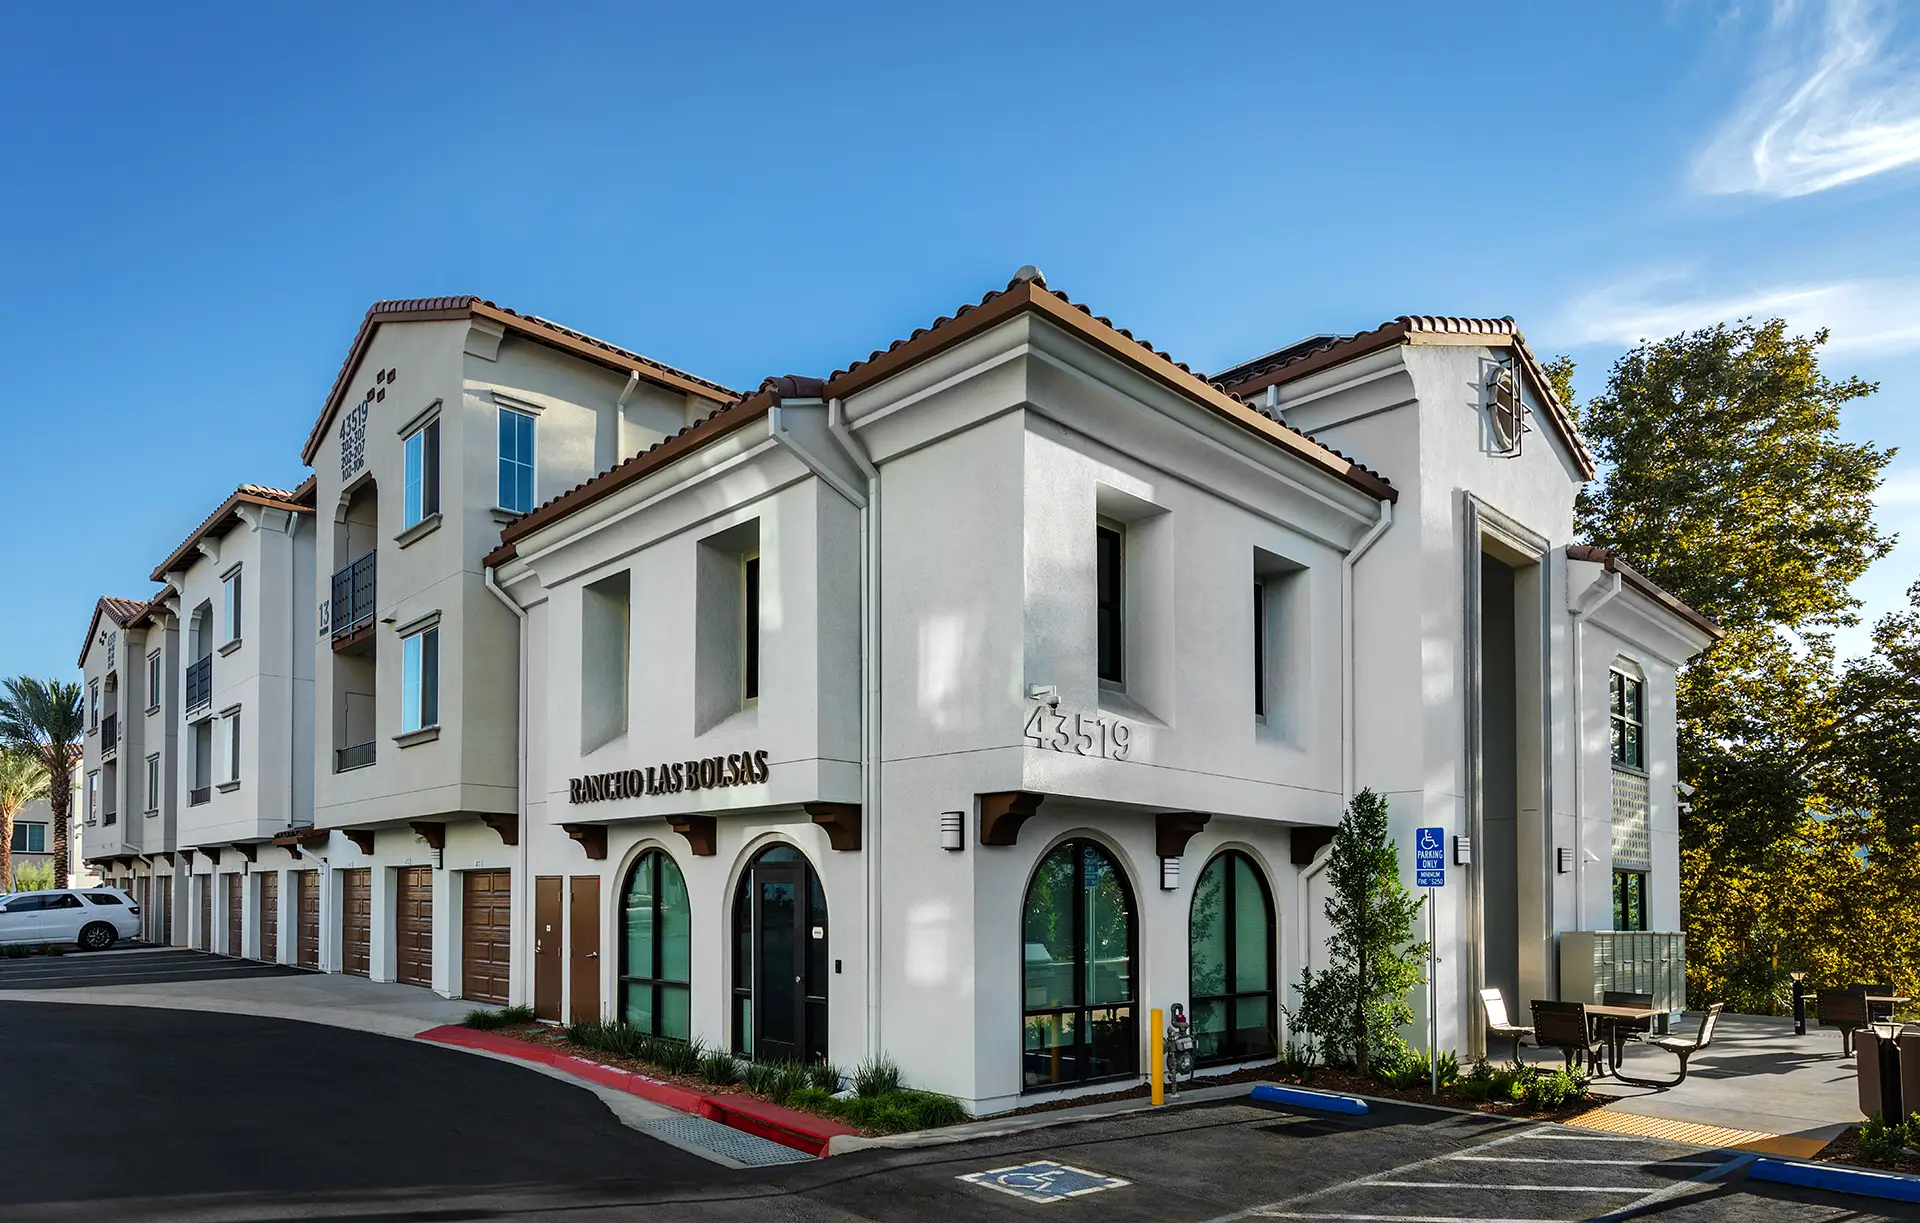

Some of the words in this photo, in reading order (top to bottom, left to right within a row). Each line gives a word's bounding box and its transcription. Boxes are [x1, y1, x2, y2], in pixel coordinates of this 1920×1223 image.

[340, 399, 368, 441] 43519
[318, 599, 330, 627] 13
[1024, 705, 1133, 762] 43519
[568, 769, 645, 804] RANCHO
[645, 763, 684, 796] LAS
[685, 749, 770, 791] BOLSAS
[1417, 849, 1443, 859] PARKING
[1422, 859, 1438, 869] ONLY
